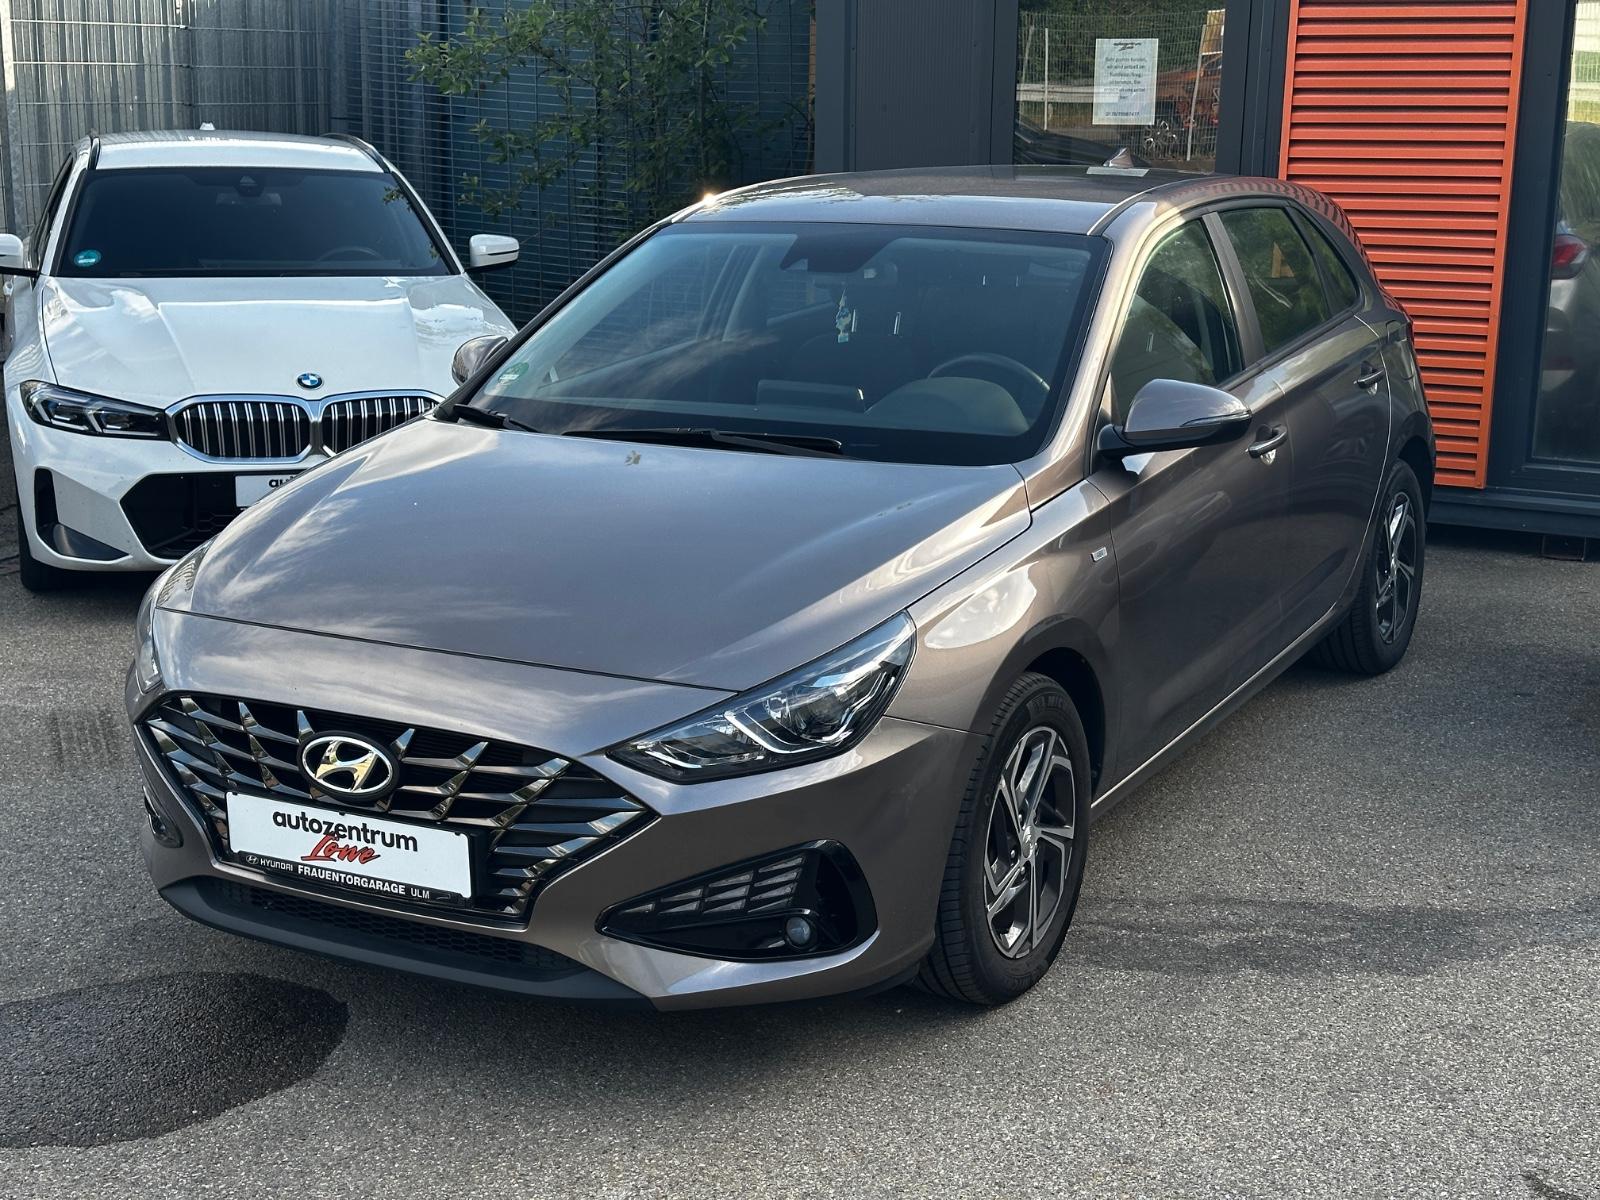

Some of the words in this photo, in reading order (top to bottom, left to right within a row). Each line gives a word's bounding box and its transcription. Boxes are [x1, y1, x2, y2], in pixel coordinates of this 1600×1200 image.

[272, 811, 418, 852] autozentrum
[260, 858, 293, 872] HYUNDAI
[298, 865, 406, 895] FRAUENTORGARAGE
[410, 887, 430, 899] ULM
